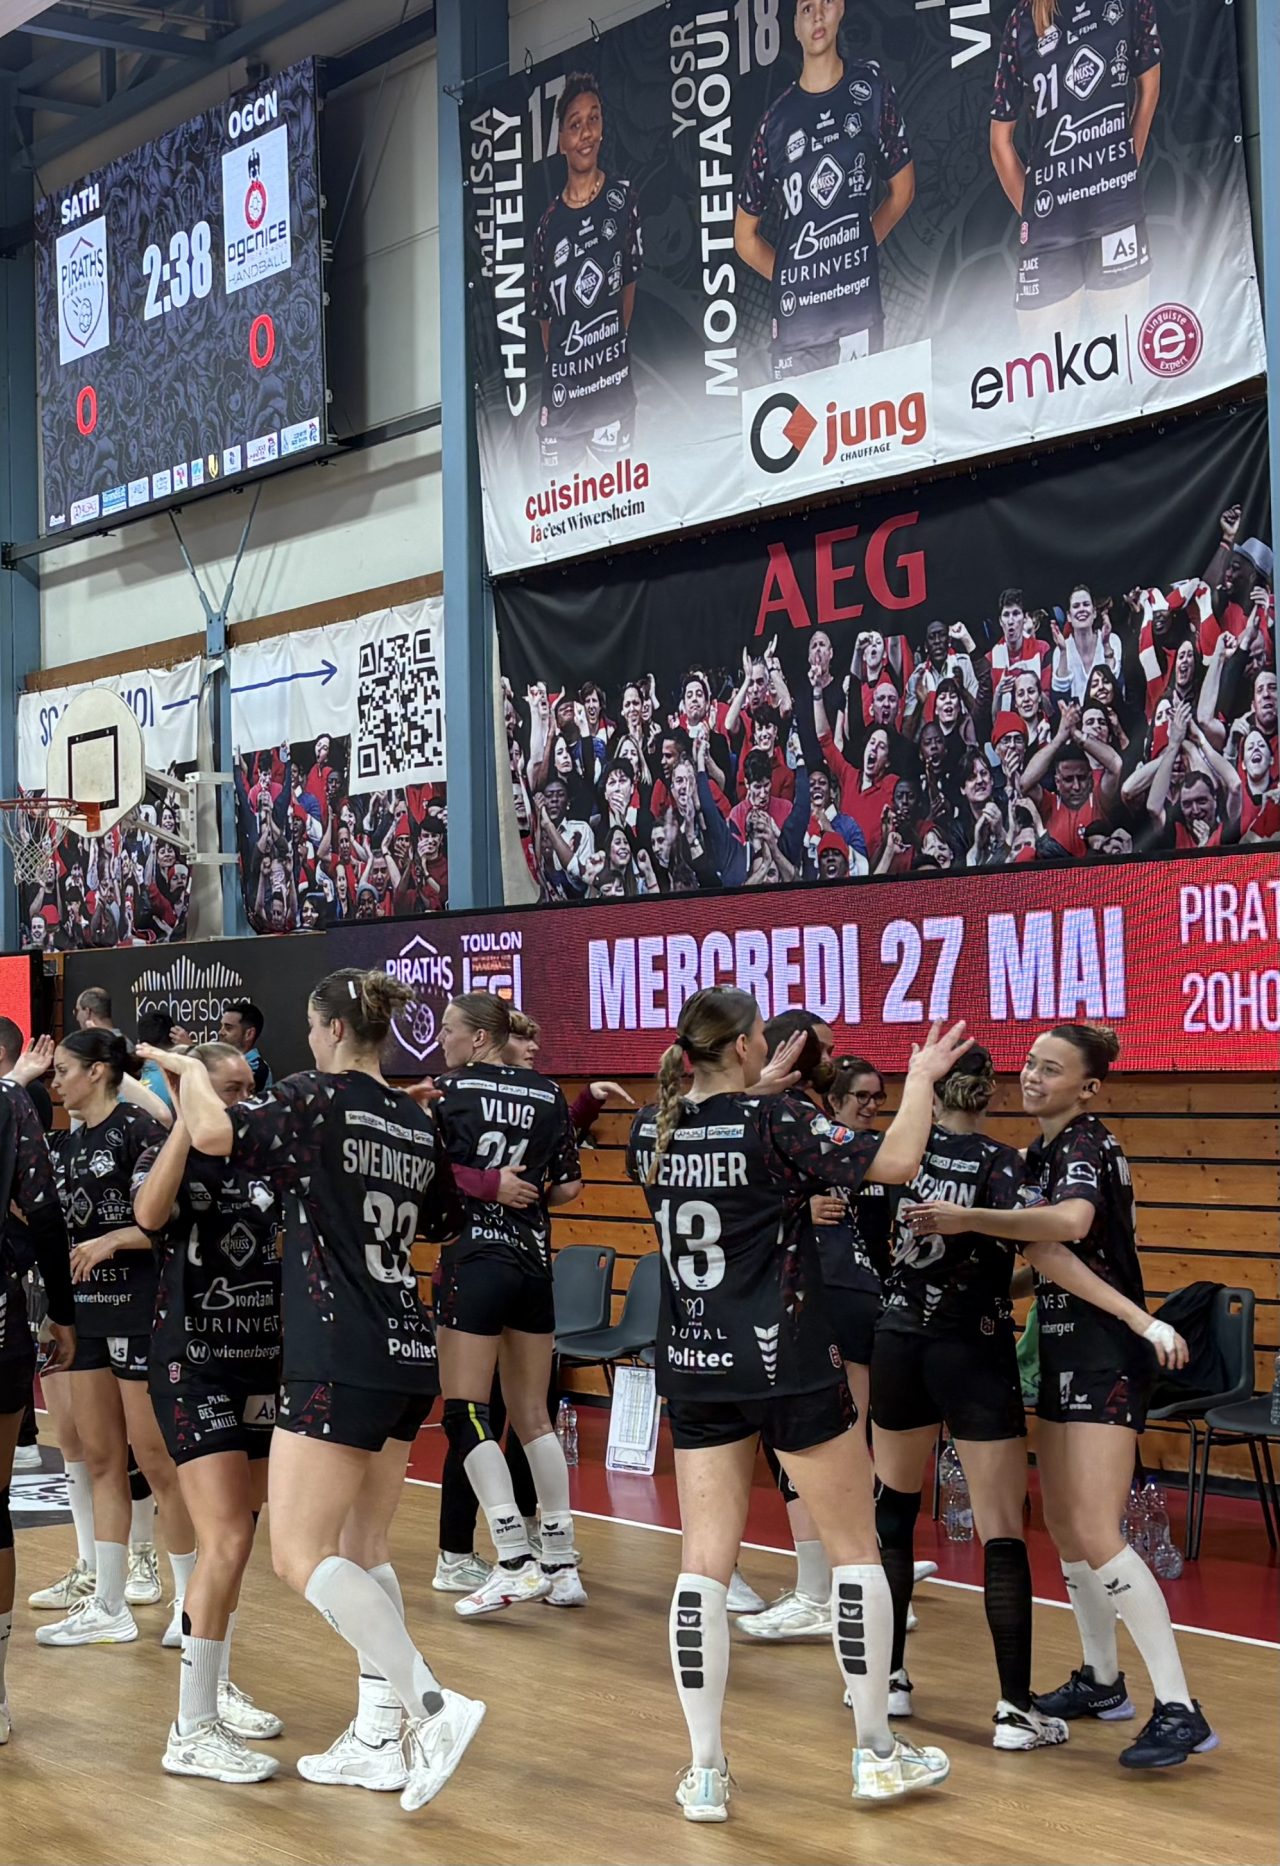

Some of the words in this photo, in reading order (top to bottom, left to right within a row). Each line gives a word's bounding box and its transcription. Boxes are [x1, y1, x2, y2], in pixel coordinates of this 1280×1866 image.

[733, 0, 780, 75] 18
[669, 18, 696, 139] YOSR
[1033, 63, 1058, 119] 21
[228, 89, 278, 140] OGCN
[527, 73, 567, 163] 17
[1045, 102, 1126, 157] Brondani
[1035, 138, 1135, 186] EURINVEST
[61, 183, 100, 225] SATH
[696, 9, 739, 397] MOSTEFAOUI
[782, 171, 803, 216] 18
[1057, 169, 1138, 206] wienerberger
[789, 213, 860, 260] Brondani
[1113, 238, 1135, 260] As
[62, 248, 104, 295] PIRATHS
[142, 221, 212, 321] 2:38
[492, 106, 527, 417] CHANTELLY
[780, 245, 869, 285] EURINVEST
[799, 276, 870, 306] wienerberger
[249, 313, 275, 368] 0
[1145, 311, 1187, 334] Linguiste
[551, 338, 628, 378] EURINVEST
[970, 332, 1119, 410] emka
[1160, 355, 1188, 372] Expert
[568, 366, 629, 399] wienerberger
[76, 385, 98, 436] 0
[822, 391, 927, 467] jung
[840, 441, 891, 462] CHAUFFAGE
[525, 458, 650, 522] cuisinella
[567, 499, 646, 535] Wiwersheim
[753, 510, 928, 637] AEG
[1180, 880, 1280, 944] PIRAT
[460, 931, 522, 952] TOULON
[881, 916, 965, 1023] 27
[987, 906, 1127, 1021] MAI
[386, 956, 453, 990] PIRATHS
[481, 1097, 535, 1130] VLUG
[655, 1198, 726, 1291] 13
[668, 1346, 734, 1368] Politec
[198, 1407, 215, 1420] DES
